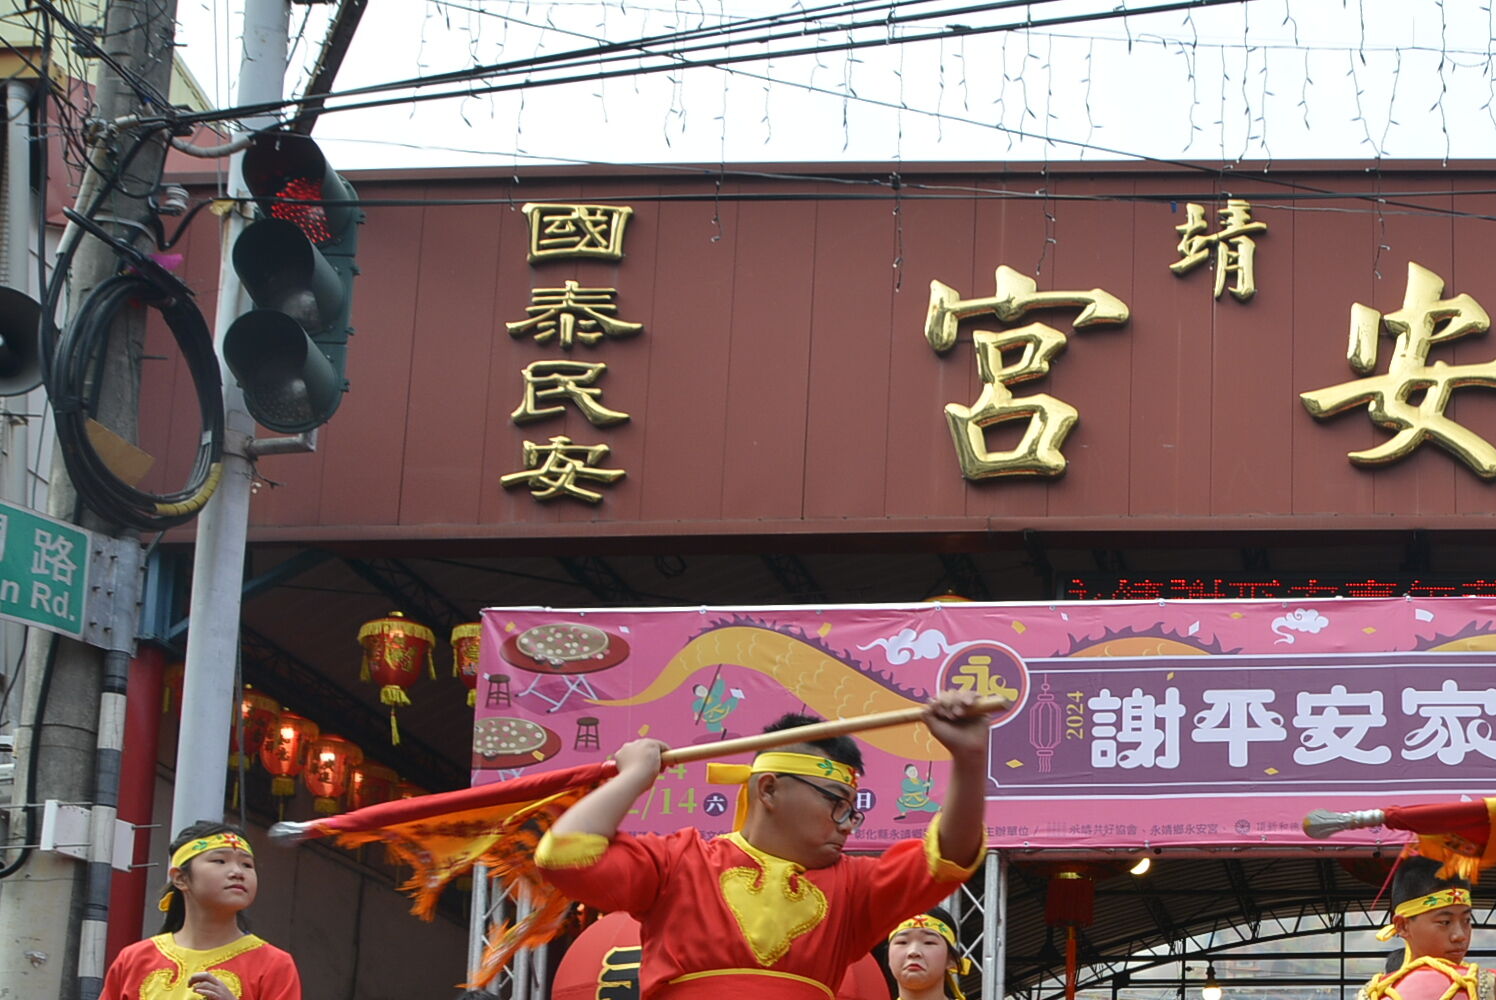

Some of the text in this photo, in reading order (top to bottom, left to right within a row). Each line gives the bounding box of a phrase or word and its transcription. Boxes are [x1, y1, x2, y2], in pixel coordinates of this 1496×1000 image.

[500, 202, 644, 505] 國泰民安
[30, 580, 75, 622] Rd.
[1066, 690, 1084, 740] 2024
[706, 795, 726, 813] 六
[856, 790, 873, 810] 日
